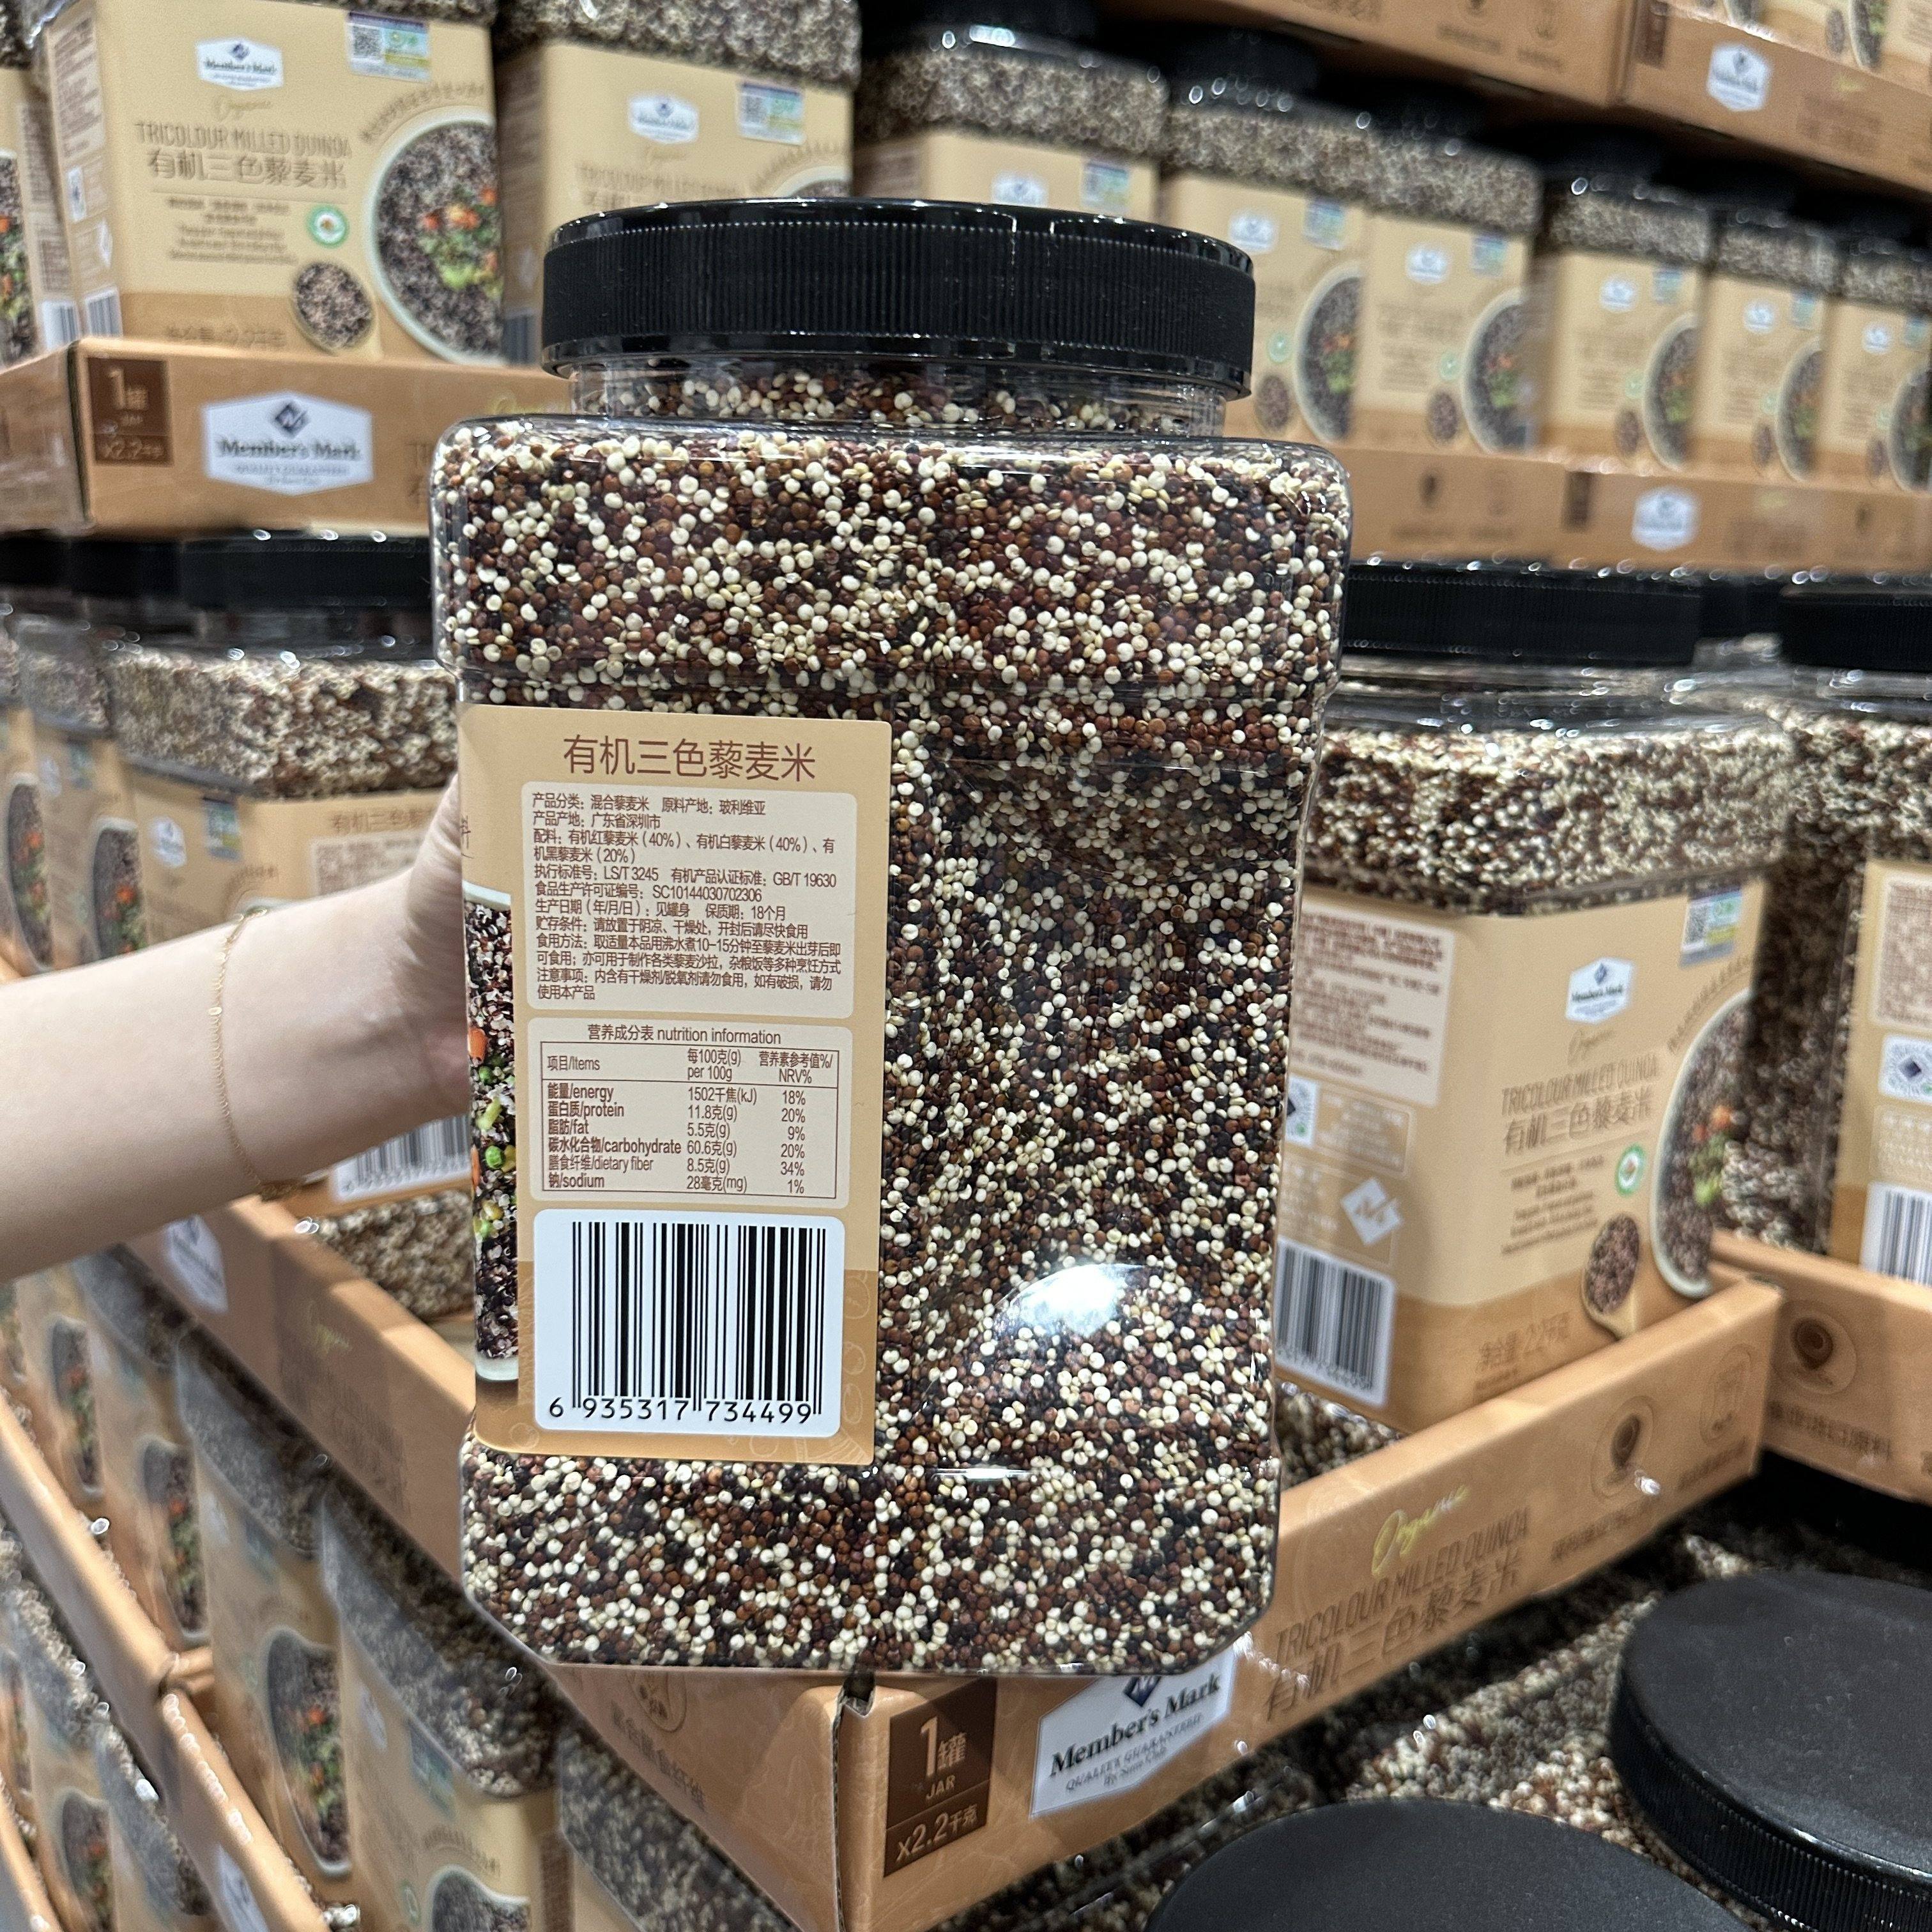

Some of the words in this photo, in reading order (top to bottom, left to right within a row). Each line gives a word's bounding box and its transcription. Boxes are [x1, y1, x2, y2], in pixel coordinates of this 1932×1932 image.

[564, 734, 816, 782] 有机三色藜麦米
[533, 811, 661, 829] 产品产地：广东省深圳市
[631, 867, 659, 881] 3245
[804, 873, 837, 887] 19630
[537, 985, 595, 1000] 使用本产品
[588, 1023, 654, 1041] 营养成分表
[657, 1027, 708, 1042] nutrition
[711, 1027, 781, 1045] information
[687, 1048, 742, 1067] 每100克(g)
[687, 1068, 704, 1080] per
[708, 1066, 733, 1082] 100g
[779, 1069, 812, 1084] NRV%
[548, 1082, 614, 1102] 能量/energy
[688, 1087, 757, 1105] 1502千焦(kJ)
[782, 1091, 806, 1105] 18%
[548, 1100, 625, 1119] 蛋白质/protein
[687, 1105, 738, 1123] 11.8克(g)
[781, 1108, 806, 1123] 20%
[687, 1123, 730, 1140] 5.5克(g)
[788, 1126, 805, 1141] 9%
[687, 1140, 737, 1158] 60.6克(g)
[781, 1144, 805, 1158] 20%
[631, 1155, 654, 1171] fiber
[687, 1158, 730, 1176] 8.5克(g)
[780, 1162, 804, 1176] 34%
[687, 1176, 747, 1194] 28毫克(mg)
[788, 1179, 804, 1194] 1%
[549, 1397, 564, 1418] 6
[583, 1398, 689, 1422] 935317
[706, 1400, 812, 1424] 734499
[1050, 1719, 1160, 1778] Member's
[1164, 1672, 1222, 1719] Mark
[920, 1715, 967, 1778] 1罐
[926, 1774, 956, 1800] JAR
